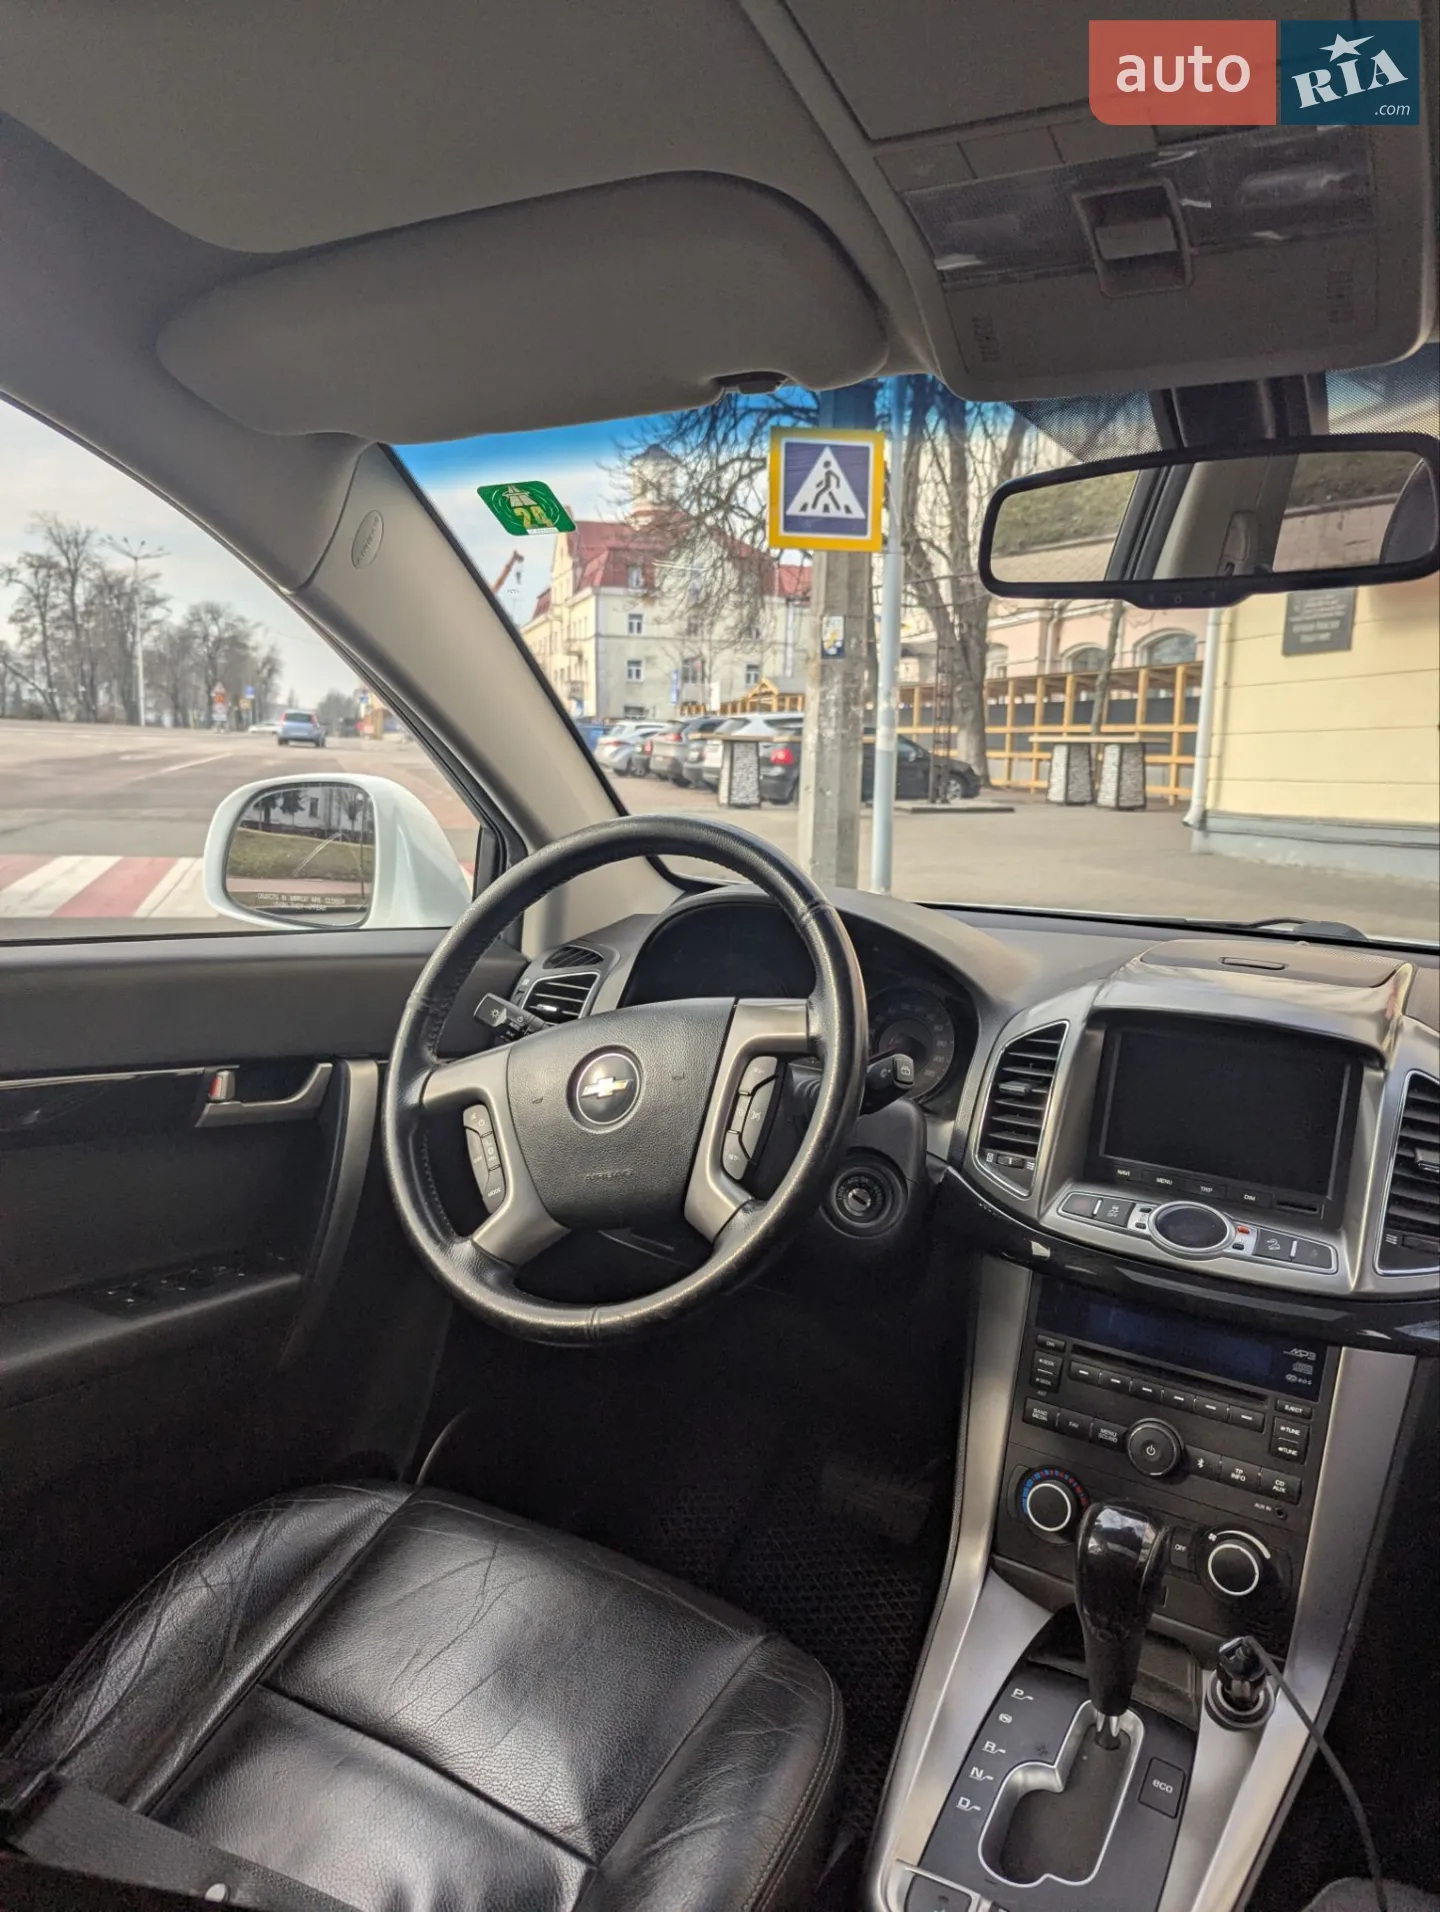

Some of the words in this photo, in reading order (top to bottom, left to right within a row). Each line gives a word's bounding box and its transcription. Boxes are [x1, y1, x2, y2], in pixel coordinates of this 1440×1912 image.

[1156, 1177, 1173, 1186] MENU
[1284, 1404, 1303, 1413] EJECT
[1100, 1428, 1118, 1437] MENU
[1285, 1426, 1301, 1436] TUNE
[1098, 1433, 1118, 1443] SOUND
[1283, 1447, 1299, 1457] TUNE
[1230, 1473, 1246, 1482] INFO
[1275, 1479, 1285, 1487] CD
[1272, 1485, 1287, 1494] AUX
[1174, 1543, 1187, 1552] OFF
[984, 1740, 997, 1751] R
[970, 1766, 985, 1778] N
[1152, 1779, 1174, 1794] eco
[957, 1796, 971, 1809] D
